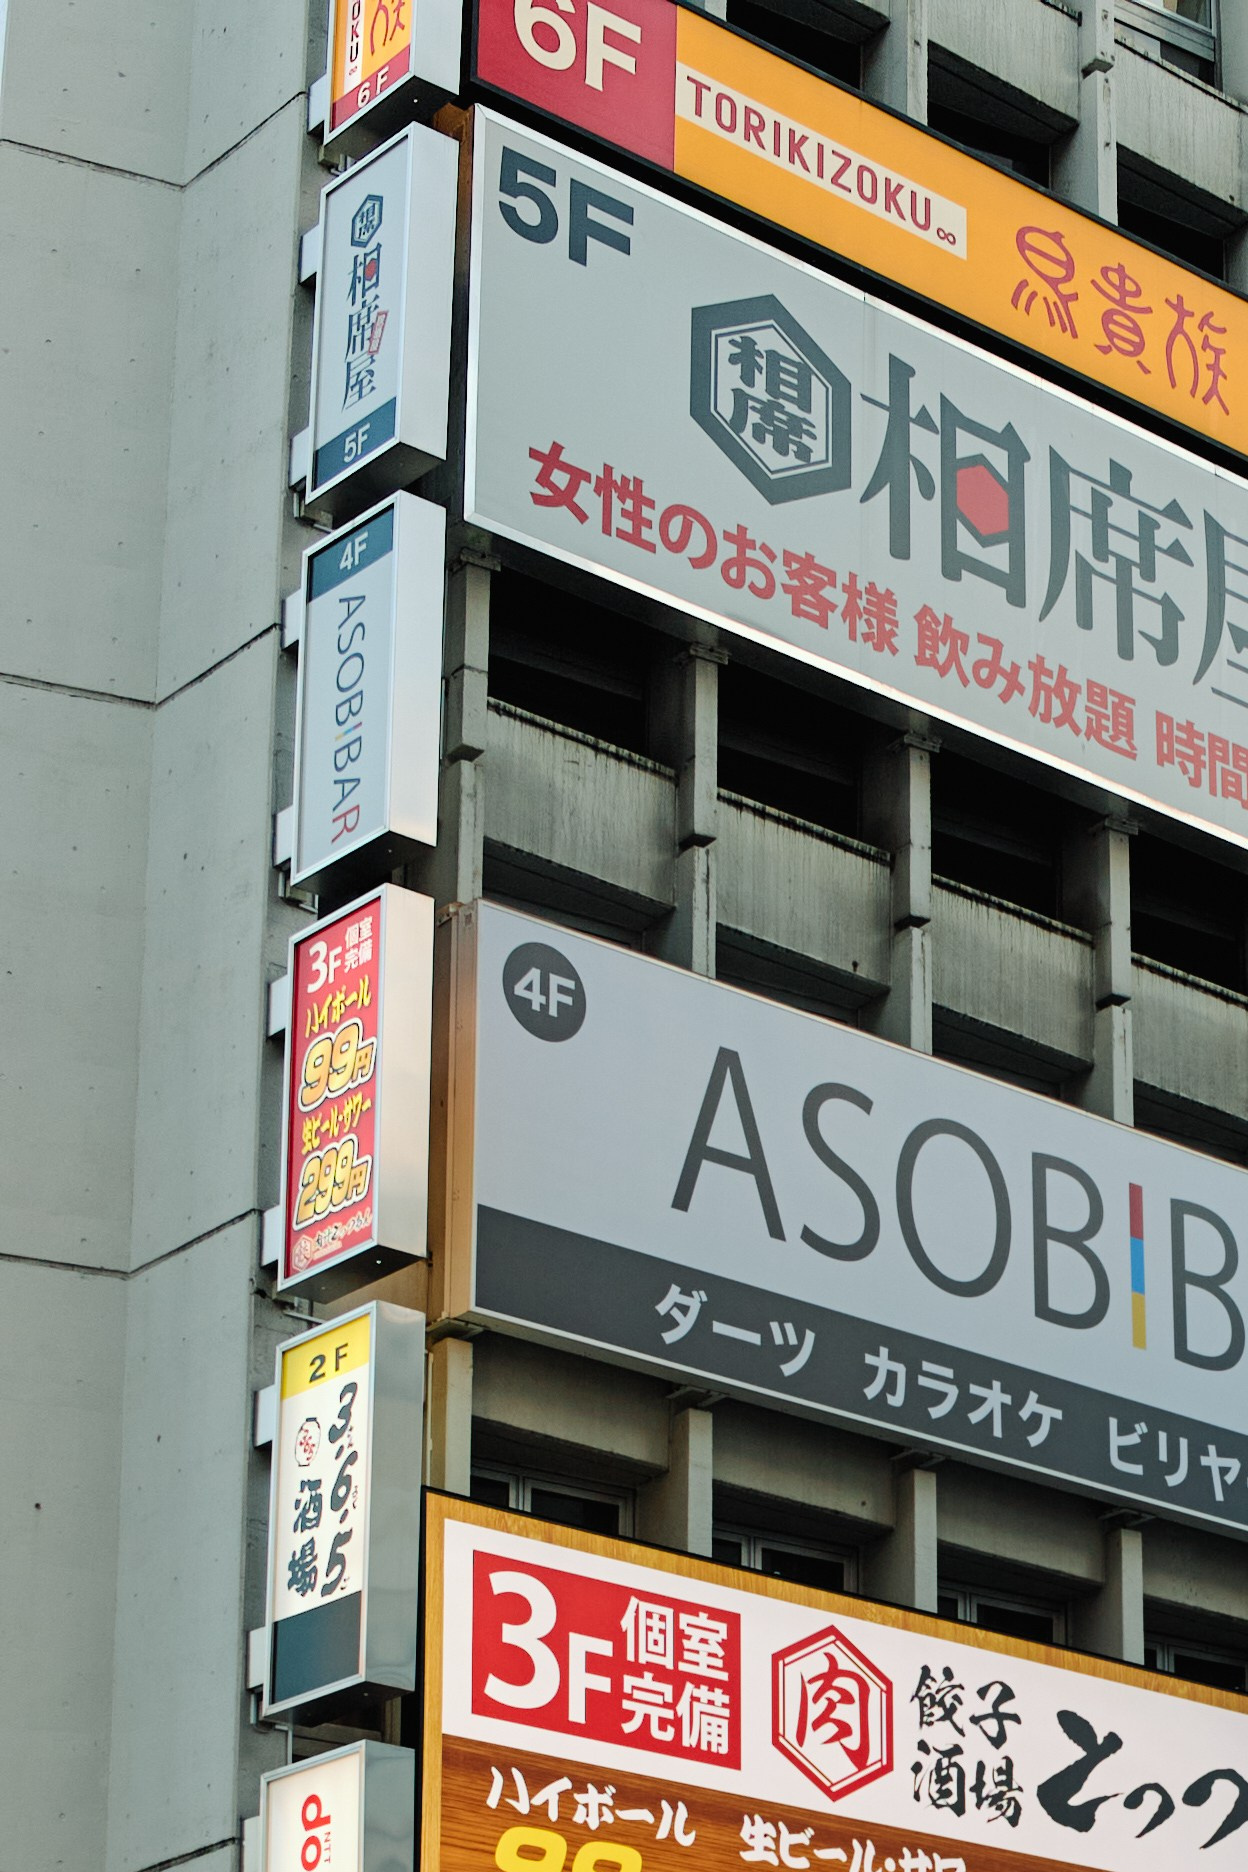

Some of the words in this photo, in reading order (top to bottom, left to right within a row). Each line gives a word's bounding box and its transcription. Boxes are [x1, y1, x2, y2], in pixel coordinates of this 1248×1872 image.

[357, 66, 390, 108] 6F
[513, 0, 643, 91] 6F
[686, 75, 932, 234] TORIKIZOKU
[498, 145, 635, 267] 5F
[341, 242, 383, 413] 相席屋
[343, 422, 371, 464] 5F
[339, 533, 368, 570] 4F
[529, 440, 900, 657] 女性のお客様
[914, 604, 1138, 761] 飲み放題
[331, 594, 366, 845] ASOBIBAR
[307, 941, 342, 994] 3F
[344, 916, 373, 950] 個室
[305, 974, 372, 1038] ハイボール
[514, 968, 576, 1017] 4F
[309, 1342, 349, 1384] 2F
[655, 1284, 816, 1377] ダーツ
[863, 1346, 1063, 1447] カラオケ
[287, 1479, 322, 1597] 酒場
[484, 1571, 614, 1725] 3F
[620, 1596, 730, 1683] 個室
[621, 1671, 730, 1755] 完備
[910, 1665, 1021, 1749] 餃子
[486, 1767, 697, 1847] ハイボール
[911, 1740, 1024, 1828] 酒場
[323, 1831, 332, 1865] NTT
